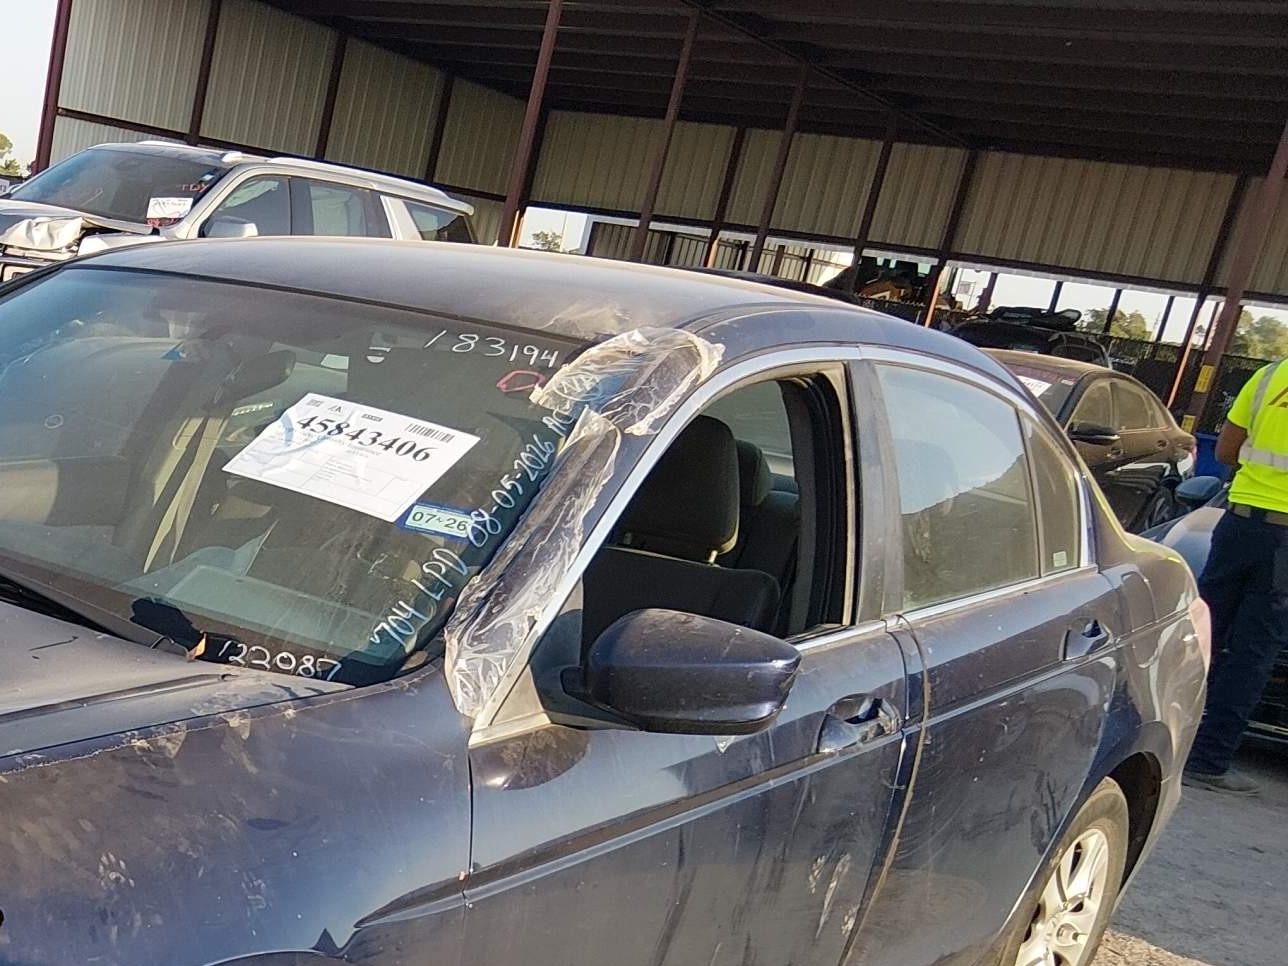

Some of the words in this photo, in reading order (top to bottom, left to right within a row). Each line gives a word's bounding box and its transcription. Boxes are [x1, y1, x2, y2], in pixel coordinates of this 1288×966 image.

[424, 328, 560, 368] 183194
[296, 414, 438, 462] 45843406
[412, 547, 469, 600] LPD
[466, 434, 556, 548] 08-05-2026
